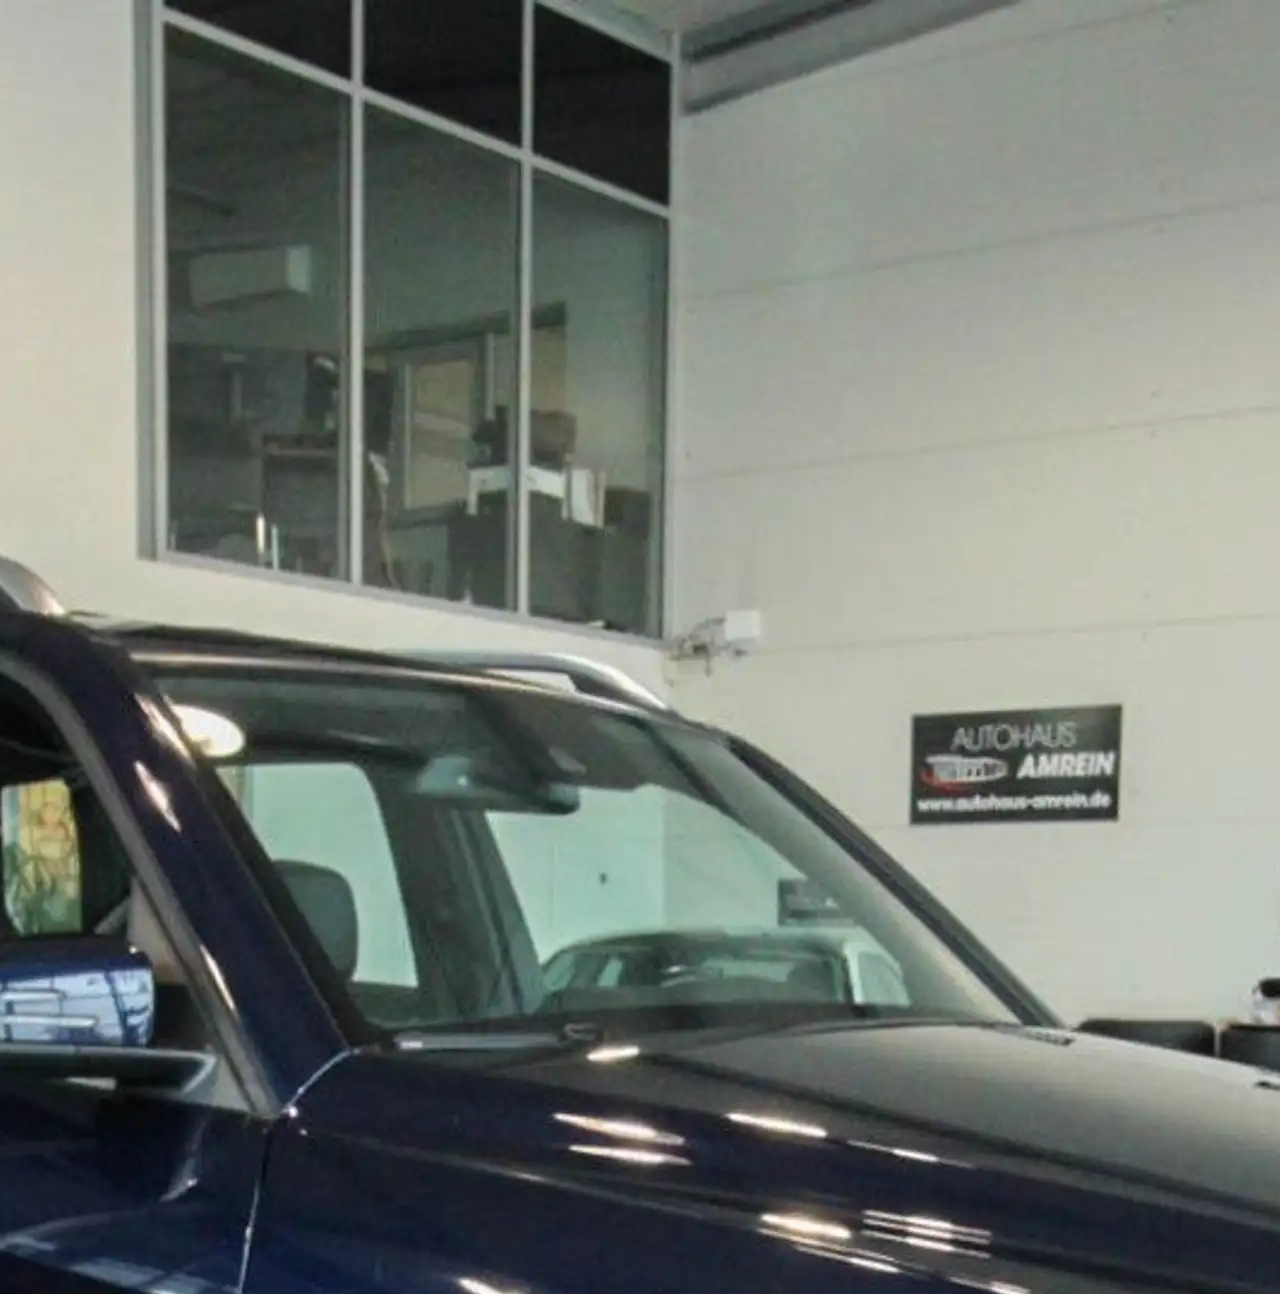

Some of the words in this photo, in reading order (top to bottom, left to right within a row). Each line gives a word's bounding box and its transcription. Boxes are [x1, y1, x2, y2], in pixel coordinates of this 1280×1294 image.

[950, 720, 1078, 752] AUTOHAUS
[1016, 749, 1116, 780] AMREIN
[917, 788, 1111, 812] www.autohaus-amrein.de
